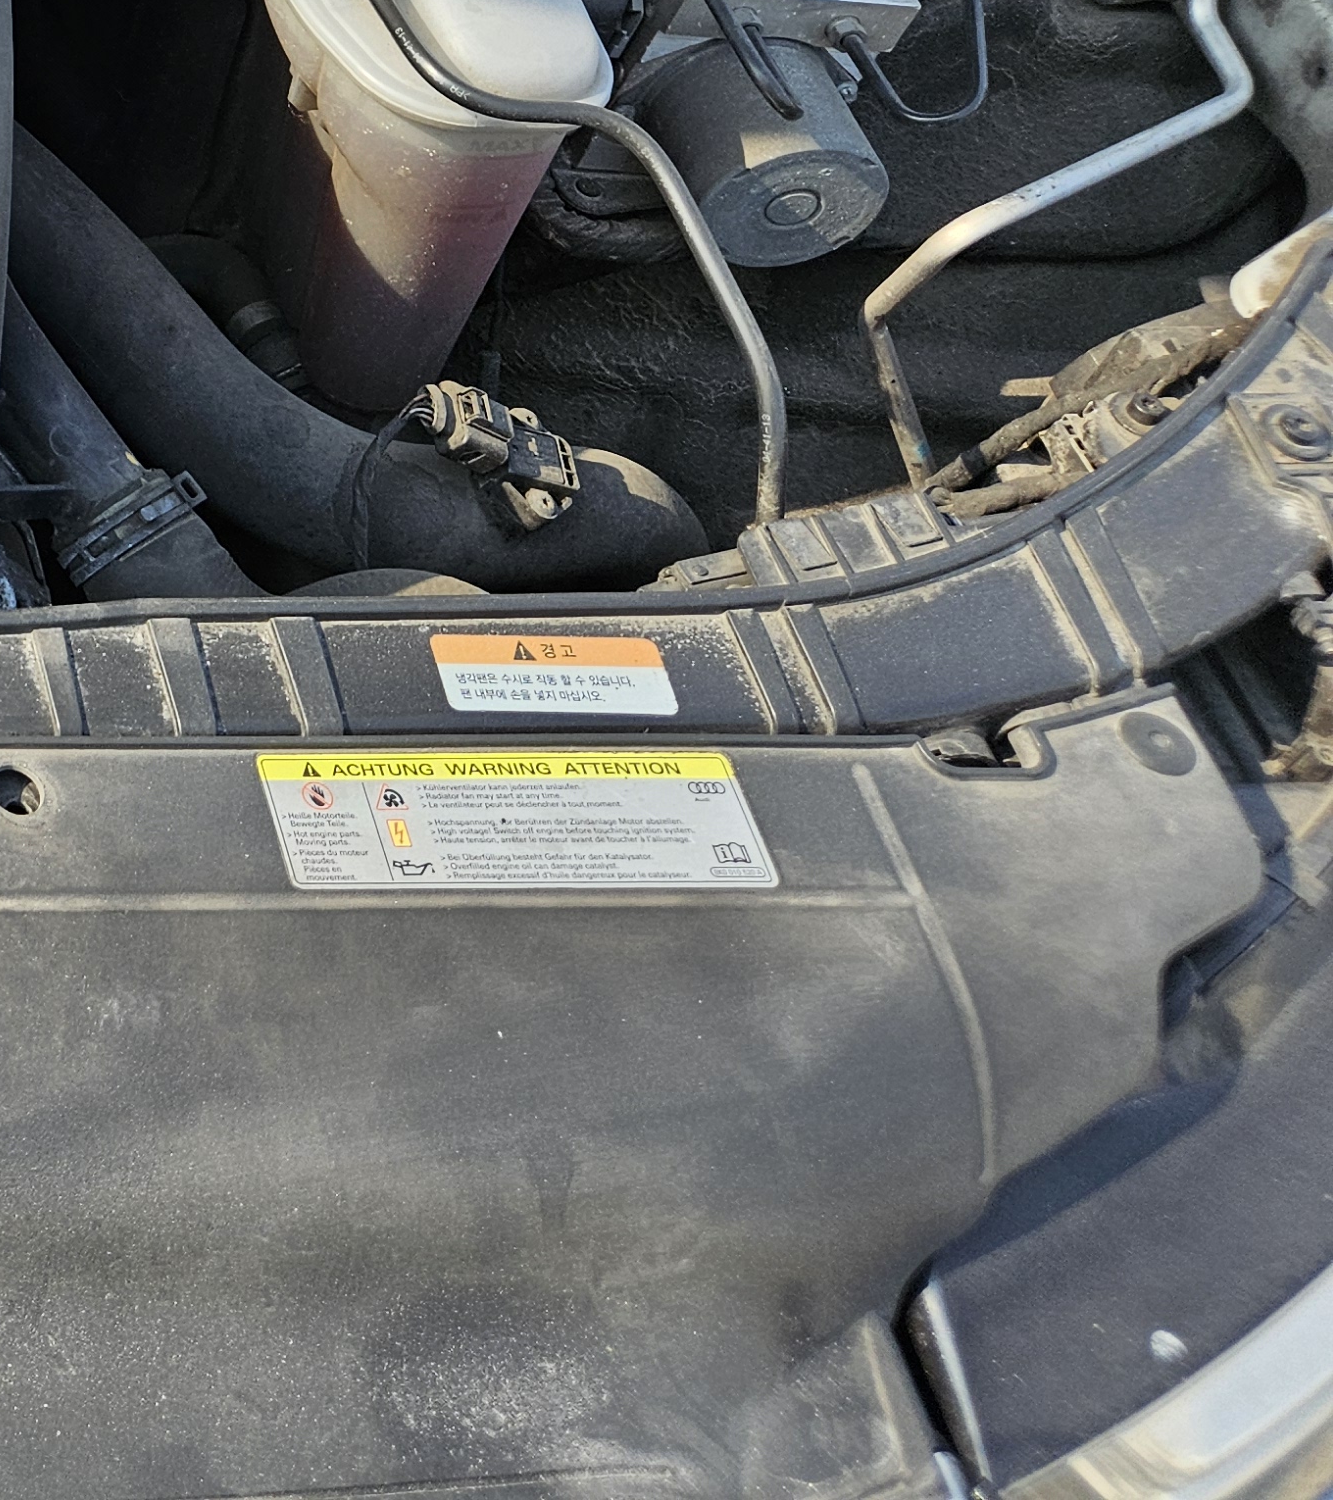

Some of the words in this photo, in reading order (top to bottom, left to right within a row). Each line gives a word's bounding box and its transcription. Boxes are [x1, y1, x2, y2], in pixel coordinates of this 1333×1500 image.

[761, 413, 772, 464] 04-41-13
[455, 672, 498, 684] 냉각팬은
[501, 673, 534, 685] 수시로
[536, 674, 558, 686] 작동
[560, 674, 572, 686] 할
[575, 675, 586, 686] 수
[588, 674, 636, 688] 있습니다.
[459, 688, 472, 700] 팬
[474, 688, 508, 700] 내부에
[510, 688, 532, 701] 손을
[533, 689, 558, 701] 넣지
[558, 690, 606, 702] 마십시오.
[333, 763, 434, 777] ACHTUNG
[445, 762, 553, 776] WARNING
[565, 761, 682, 776] ATTENTION
[423, 783, 487, 791] Kühlerventilator
[488, 783, 508, 791] kann
[509, 783, 543, 792] jederzeit
[545, 783, 582, 791] anlaufen.
[425, 792, 459, 800] Radiator
[460, 792, 474, 800] fan
[476, 793, 494, 801] may
[495, 792, 514, 800] start
[428, 801, 439, 809] Le
[440, 801, 484, 809] ventilateur
[485, 801, 504, 810] peut
[515, 800, 560, 808] déclencher
[313, 812, 358, 820] Motorteile.
[290, 820, 325, 828] Bewegte
[514, 818, 552, 826] Berühren
[569, 817, 617, 826] Zündanlage
[618, 817, 643, 825] Motor
[645, 817, 684, 825] abstellen.
[309, 831, 338, 839] engine
[339, 831, 363, 839] parts.
[437, 827, 457, 835] High
[459, 827, 492, 835] voltage!
[493, 827, 521, 835] Switch
[593, 827, 630, 835] touching
[632, 827, 663, 835] ignition
[664, 827, 696, 835] system.
[295, 839, 327, 847] Moving
[328, 839, 351, 847] parts.
[466, 836, 500, 844] tension,
[447, 853, 461, 861] Bei
[462, 853, 511, 862] Überfüllung
[512, 853, 543, 861] besteht
[544, 852, 572, 860] Gefahr
[573, 852, 586, 860] für
[605, 852, 654, 861] Katalysator.
[450, 862, 490, 870] Overfilled
[491, 863, 521, 871] engine
[522, 862, 533, 870] oil
[550, 862, 583, 871] damage
[584, 862, 619, 870] catalyst.
[453, 871, 506, 880] Remplissage
[507, 871, 540, 879] excessif
[542, 871, 570, 879] d'huile
[571, 871, 615, 880] dangereux
[617, 872, 637, 880] pour
[638, 871, 646, 879] le
[647, 871, 692, 880] catalyseur.
